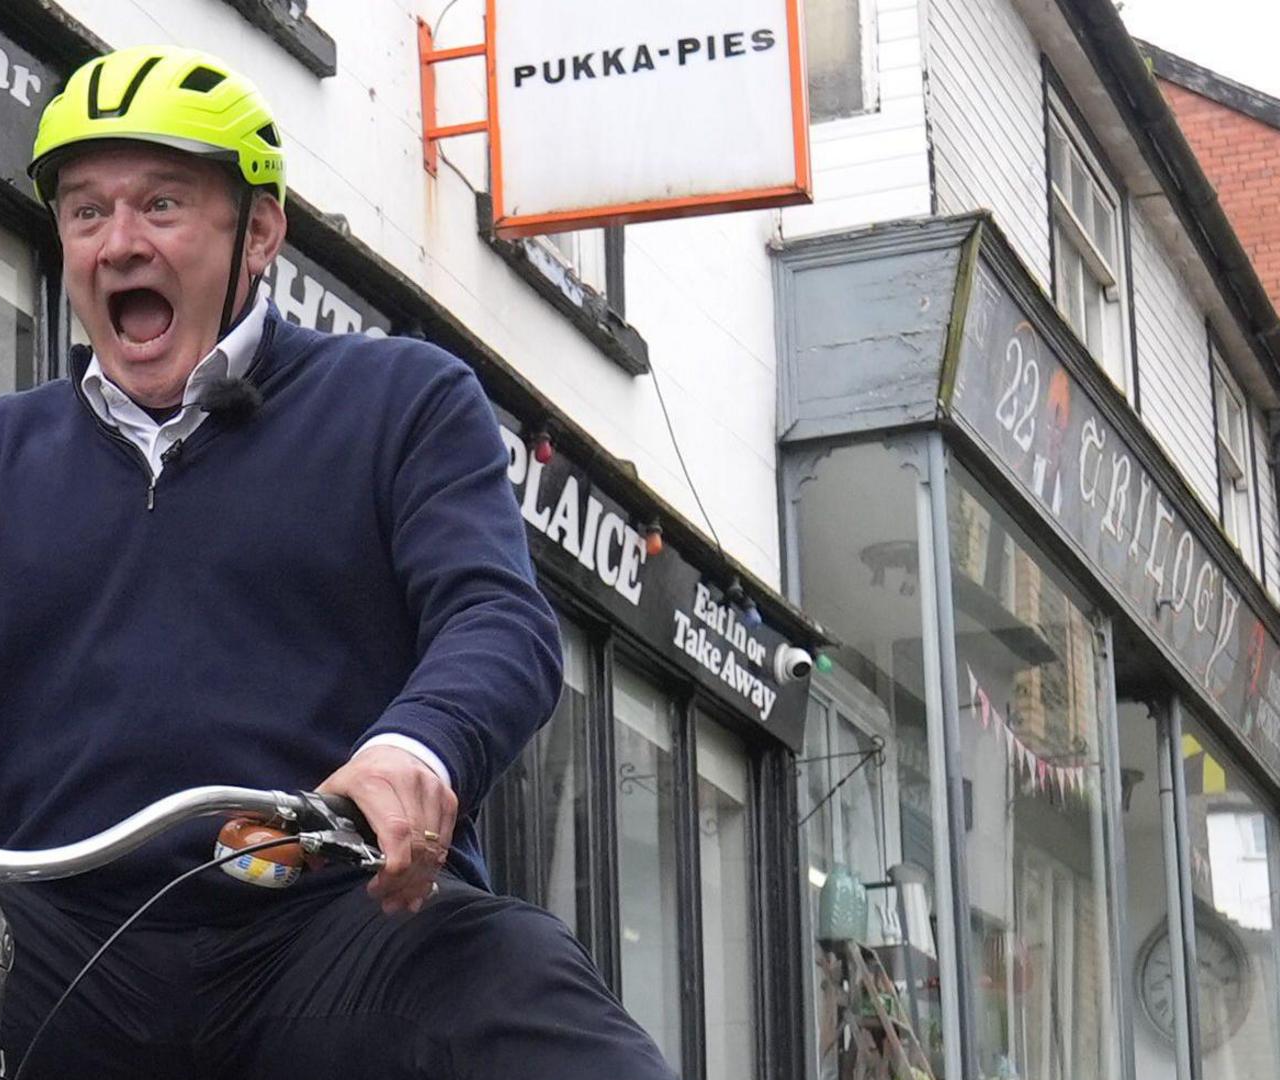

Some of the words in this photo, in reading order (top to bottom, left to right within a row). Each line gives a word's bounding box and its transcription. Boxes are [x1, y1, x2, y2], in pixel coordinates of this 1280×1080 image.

[513, 29, 776, 87] PUKKA-PIES
[995, 337, 1040, 453] 22
[499, 425, 647, 607] PLAICE
[673, 609, 722, 675] Take
[720, 651, 777, 721] Away
[693, 577, 727, 635] Eat
[724, 607, 747, 653] In
[746, 637, 766, 668] or
